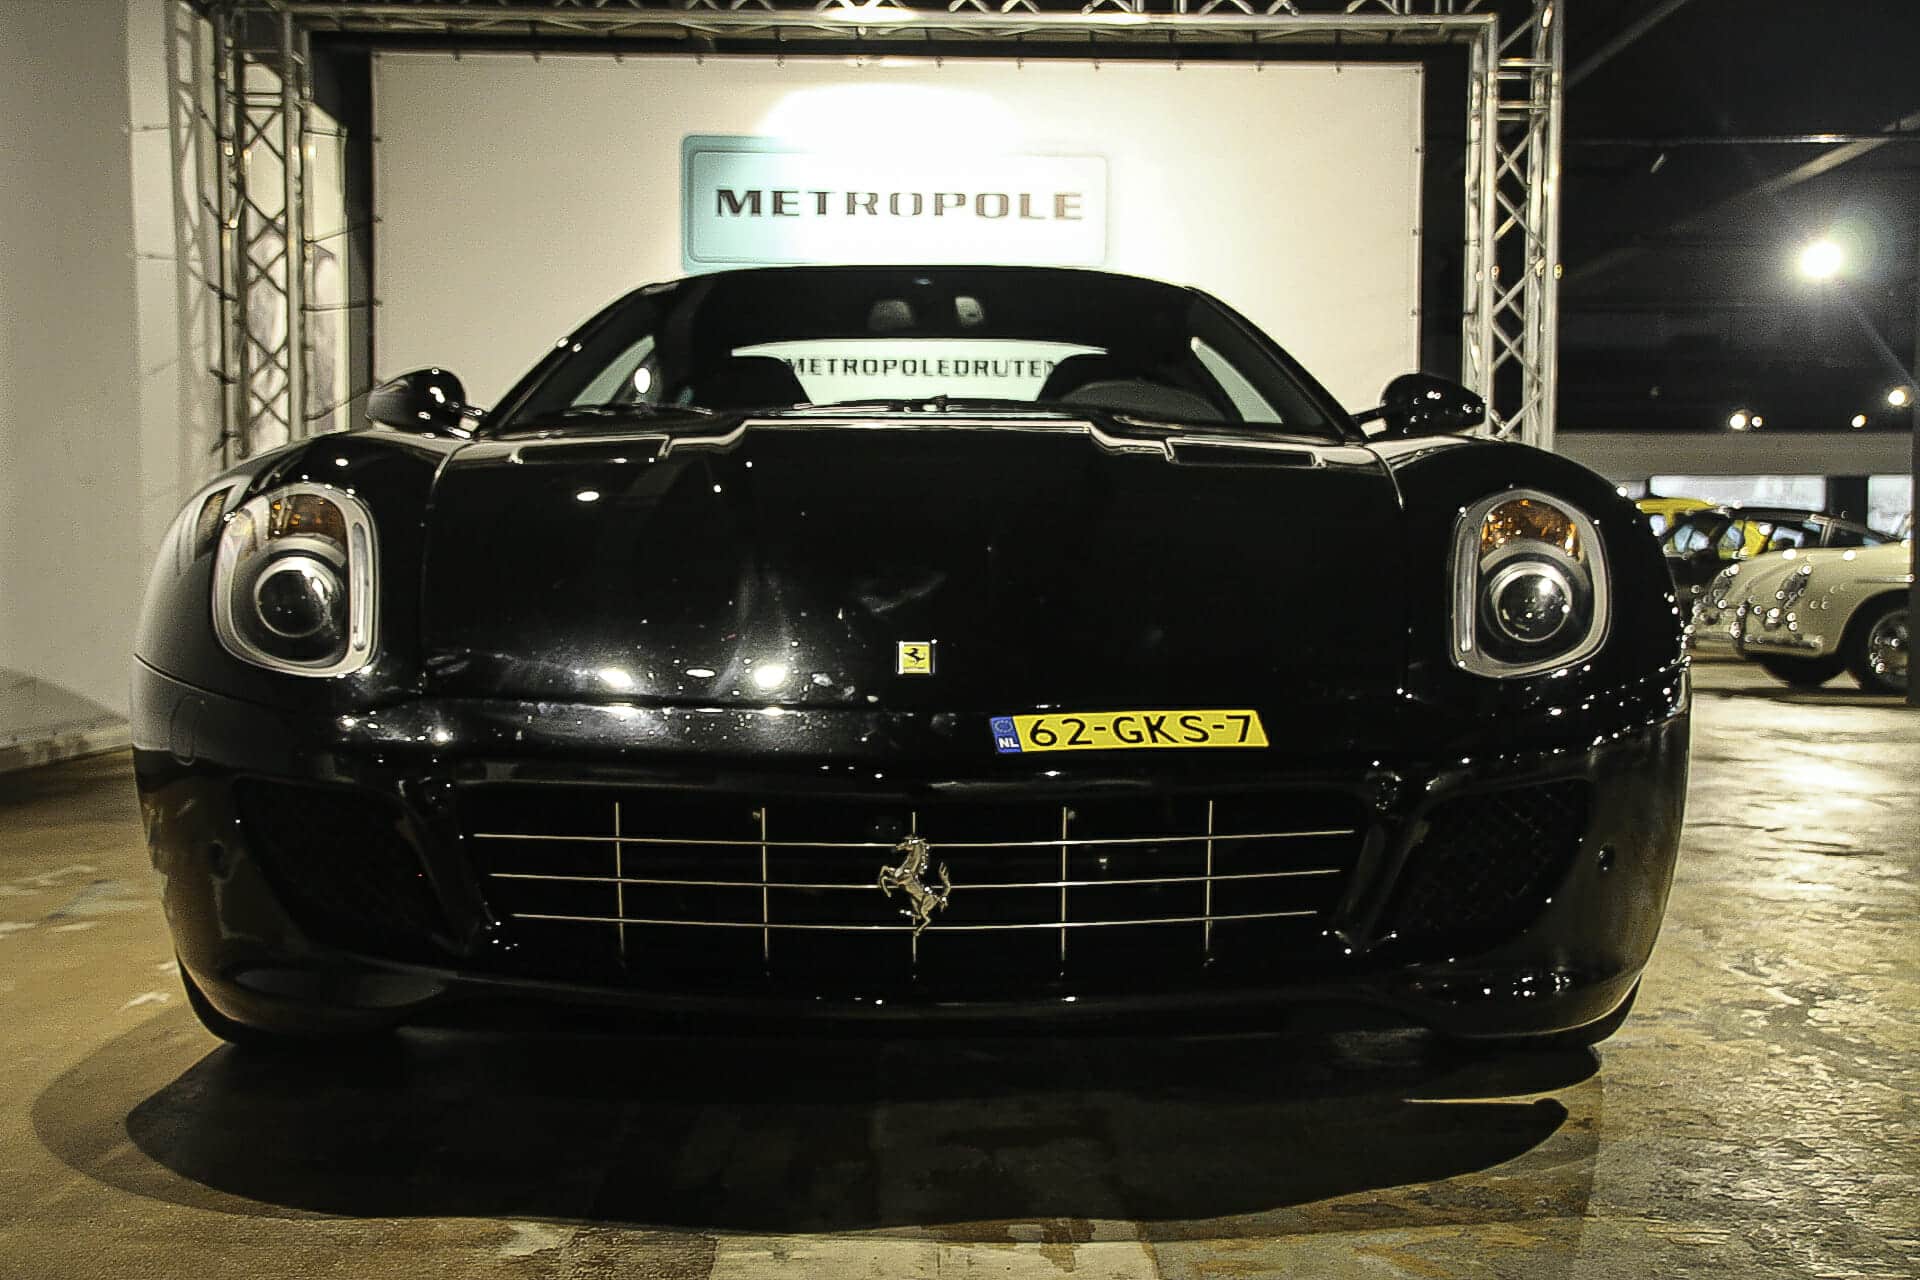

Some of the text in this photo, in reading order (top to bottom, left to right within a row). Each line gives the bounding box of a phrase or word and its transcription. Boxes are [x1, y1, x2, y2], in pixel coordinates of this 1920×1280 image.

[716, 189, 1083, 220] METROPOLE
[998, 714, 1251, 749] NL 62-GKS-7
